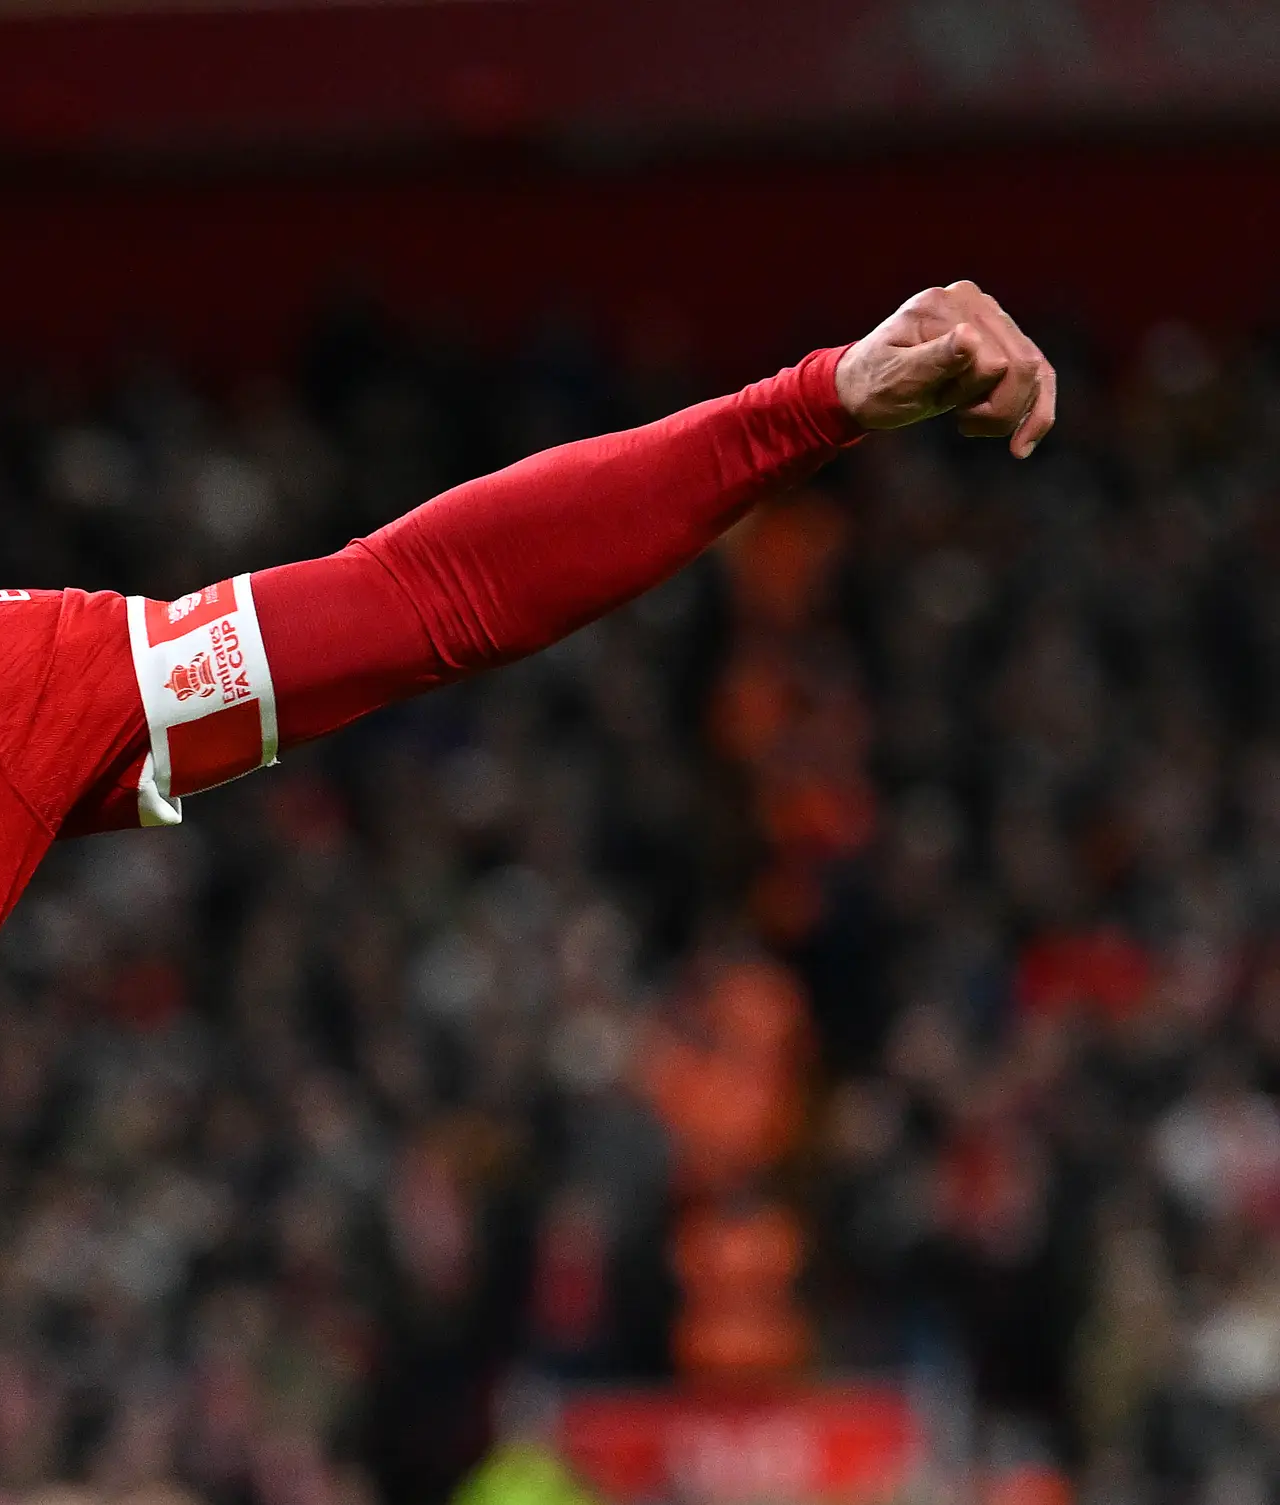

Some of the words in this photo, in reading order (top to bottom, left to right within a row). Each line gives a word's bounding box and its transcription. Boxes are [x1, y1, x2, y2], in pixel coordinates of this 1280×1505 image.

[210, 625, 236, 704] Emirates
[222, 620, 243, 669] CUP
[235, 670, 251, 698] FA
